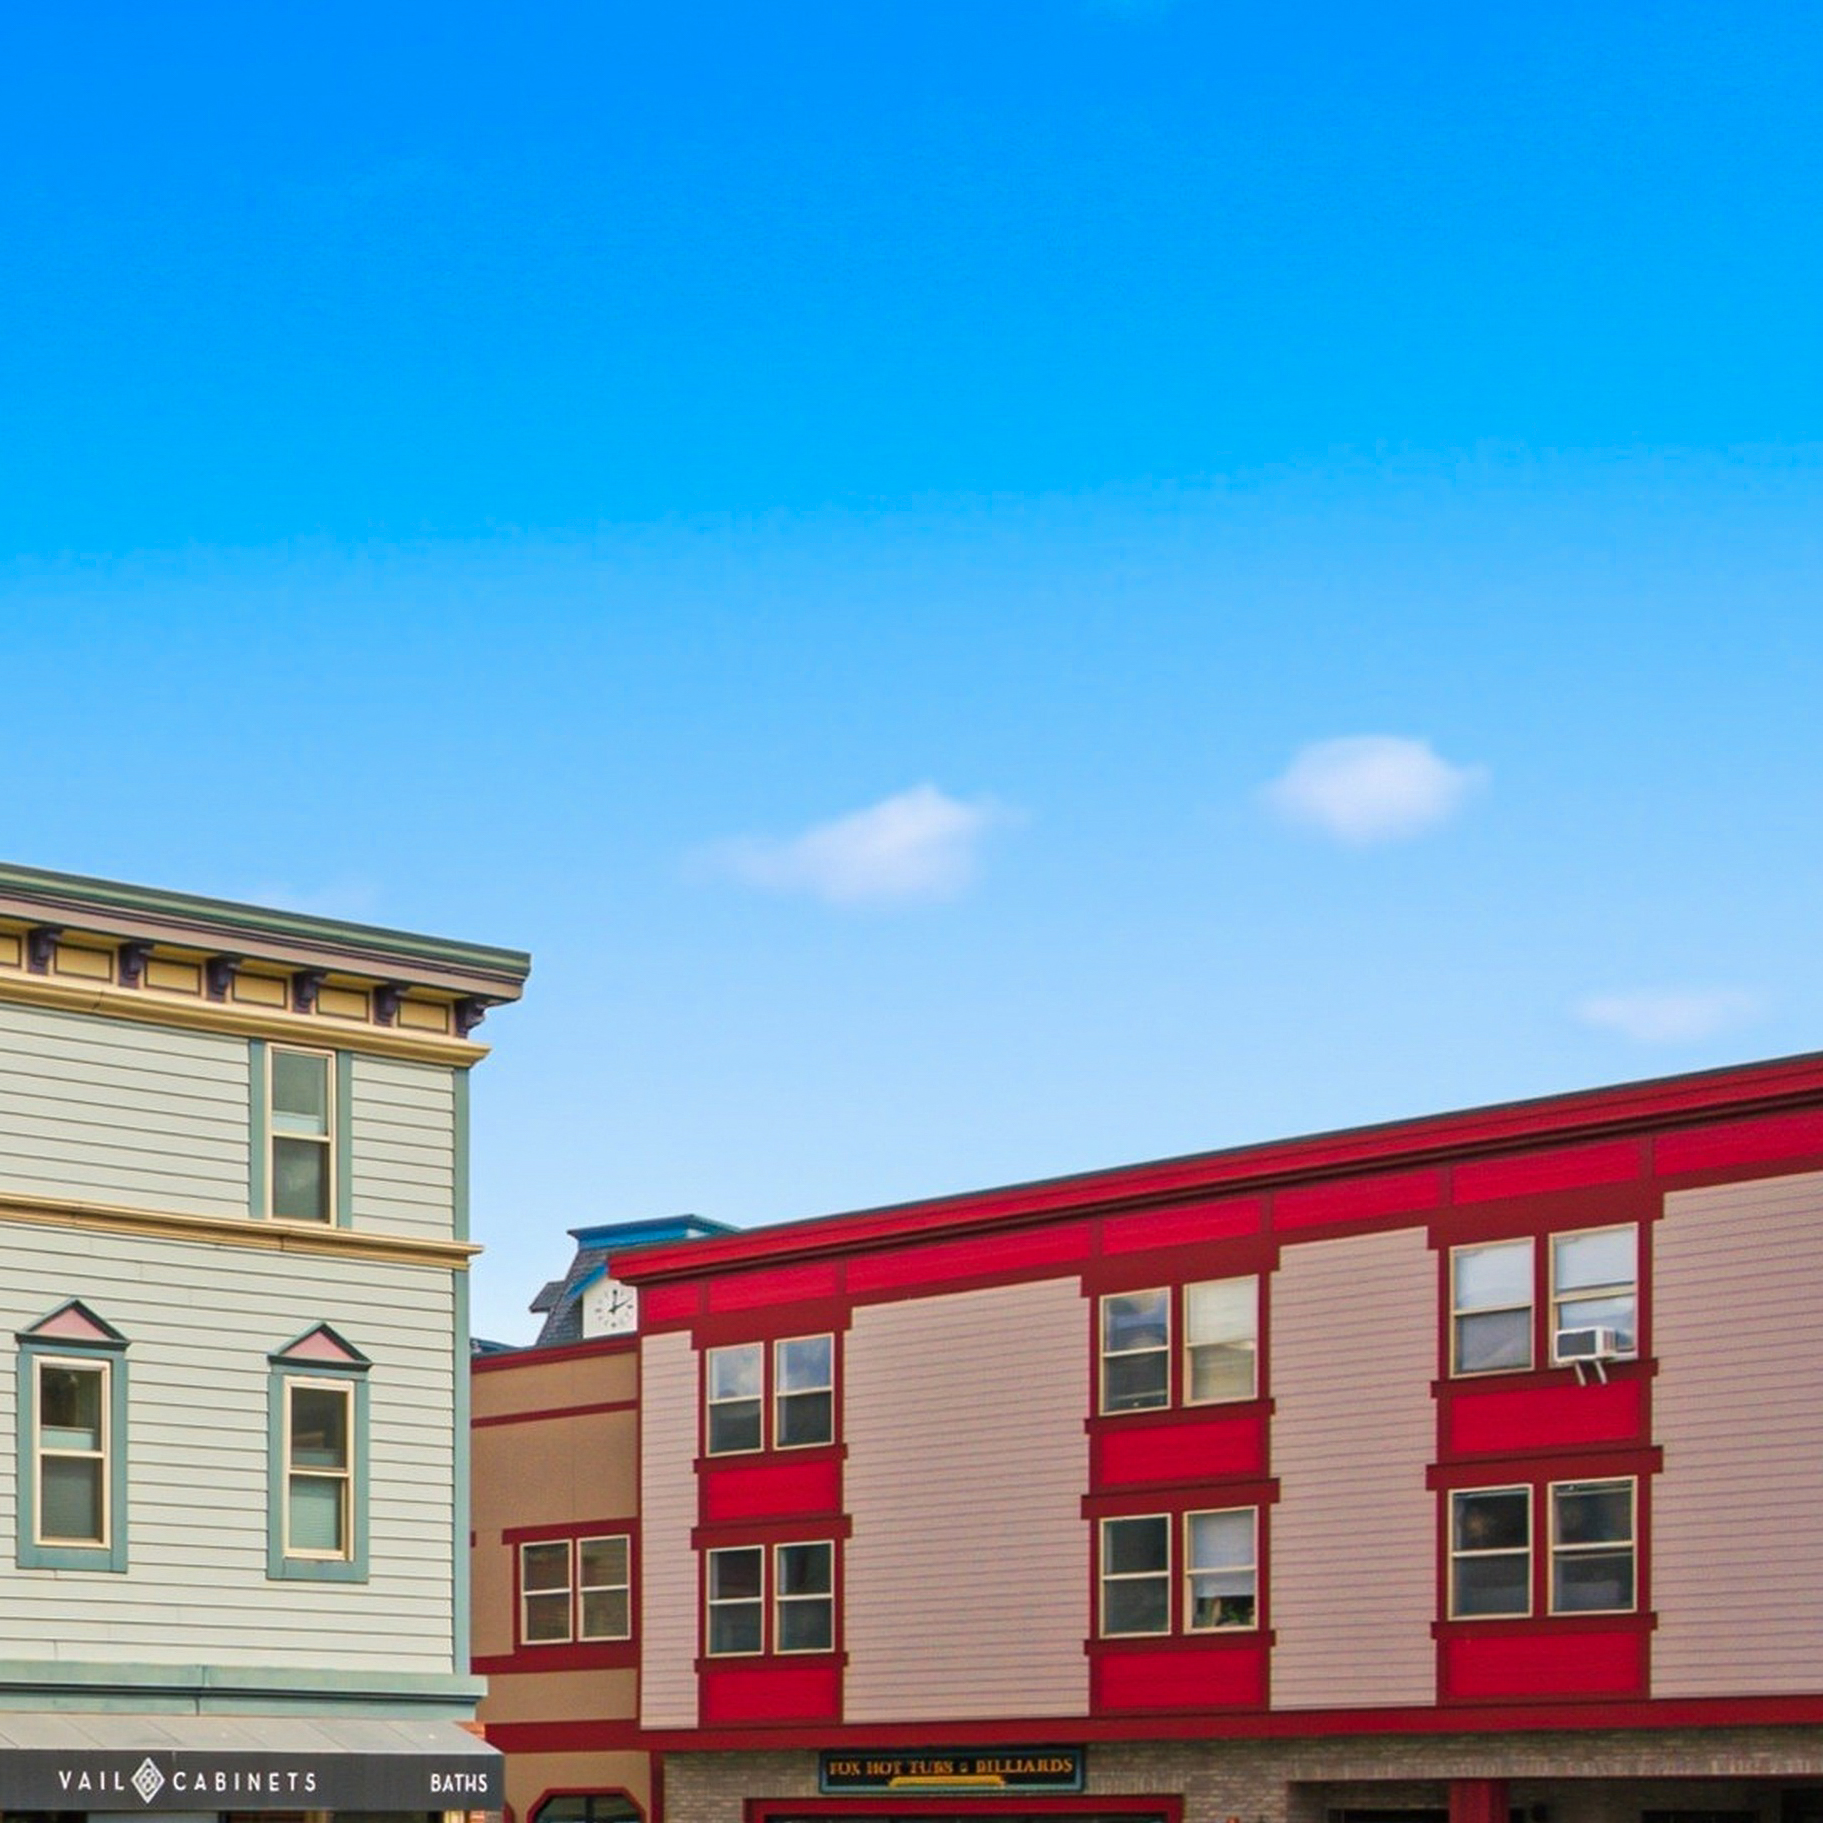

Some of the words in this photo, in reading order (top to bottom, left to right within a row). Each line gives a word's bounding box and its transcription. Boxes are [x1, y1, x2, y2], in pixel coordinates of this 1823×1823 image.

[867, 1761, 902, 1775] HOT
[976, 1758, 1074, 1774] BILLIARDS
[58, 1770, 125, 1791] VAIL
[172, 1772, 317, 1792] CABINETS
[430, 1774, 489, 1792] BATHS
